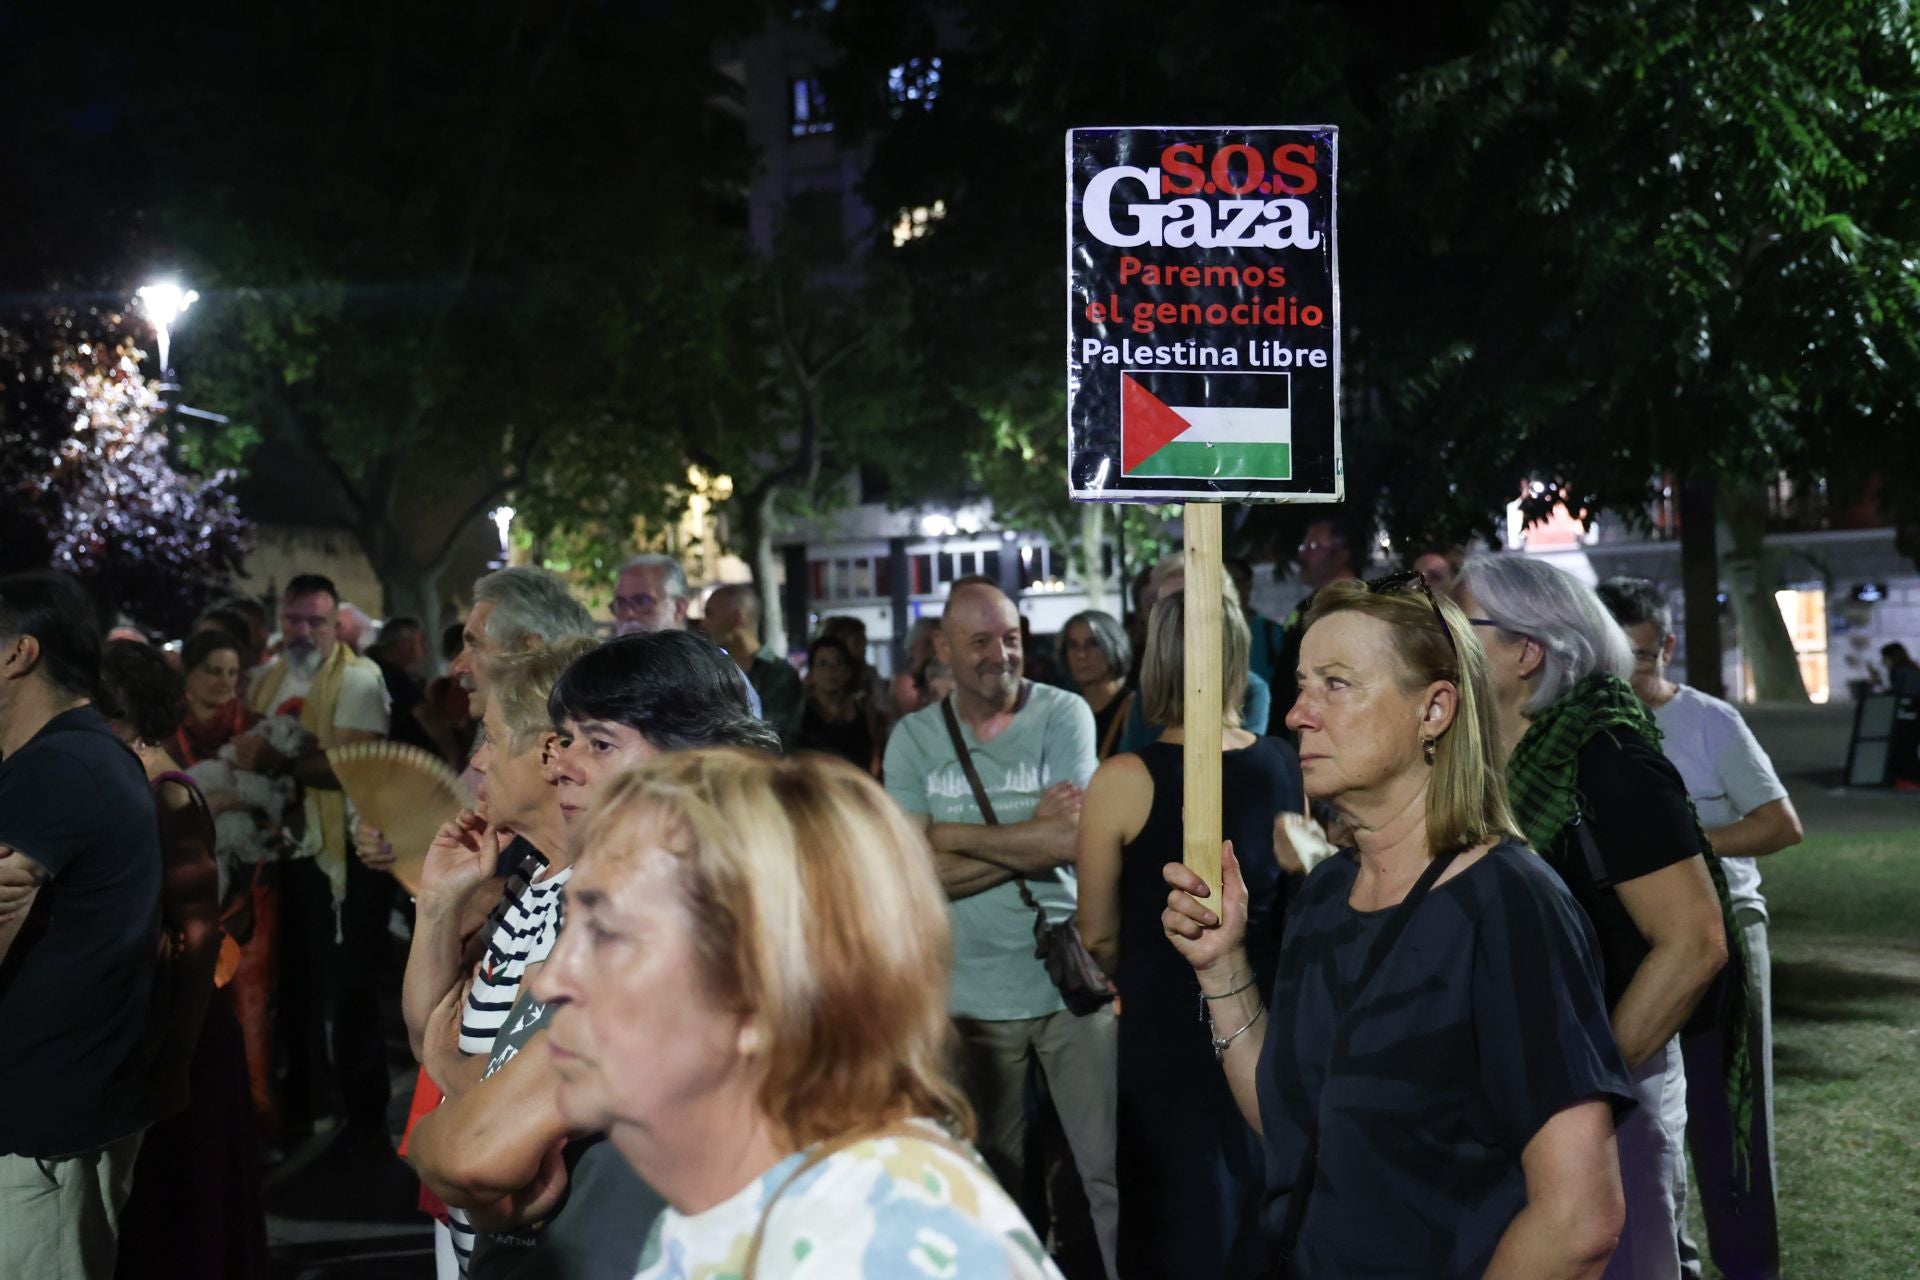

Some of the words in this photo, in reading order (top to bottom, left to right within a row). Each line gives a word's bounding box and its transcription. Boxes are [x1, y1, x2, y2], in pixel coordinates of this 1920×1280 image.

[1160, 143, 1318, 195] S.O.S
[1082, 166, 1321, 250] Gaza
[1119, 256, 1286, 288] Paremos
[1085, 294, 1123, 324] el
[1132, 297, 1324, 333] genocidio
[1082, 338, 1239, 367] Palestina
[1249, 340, 1328, 368] libre
